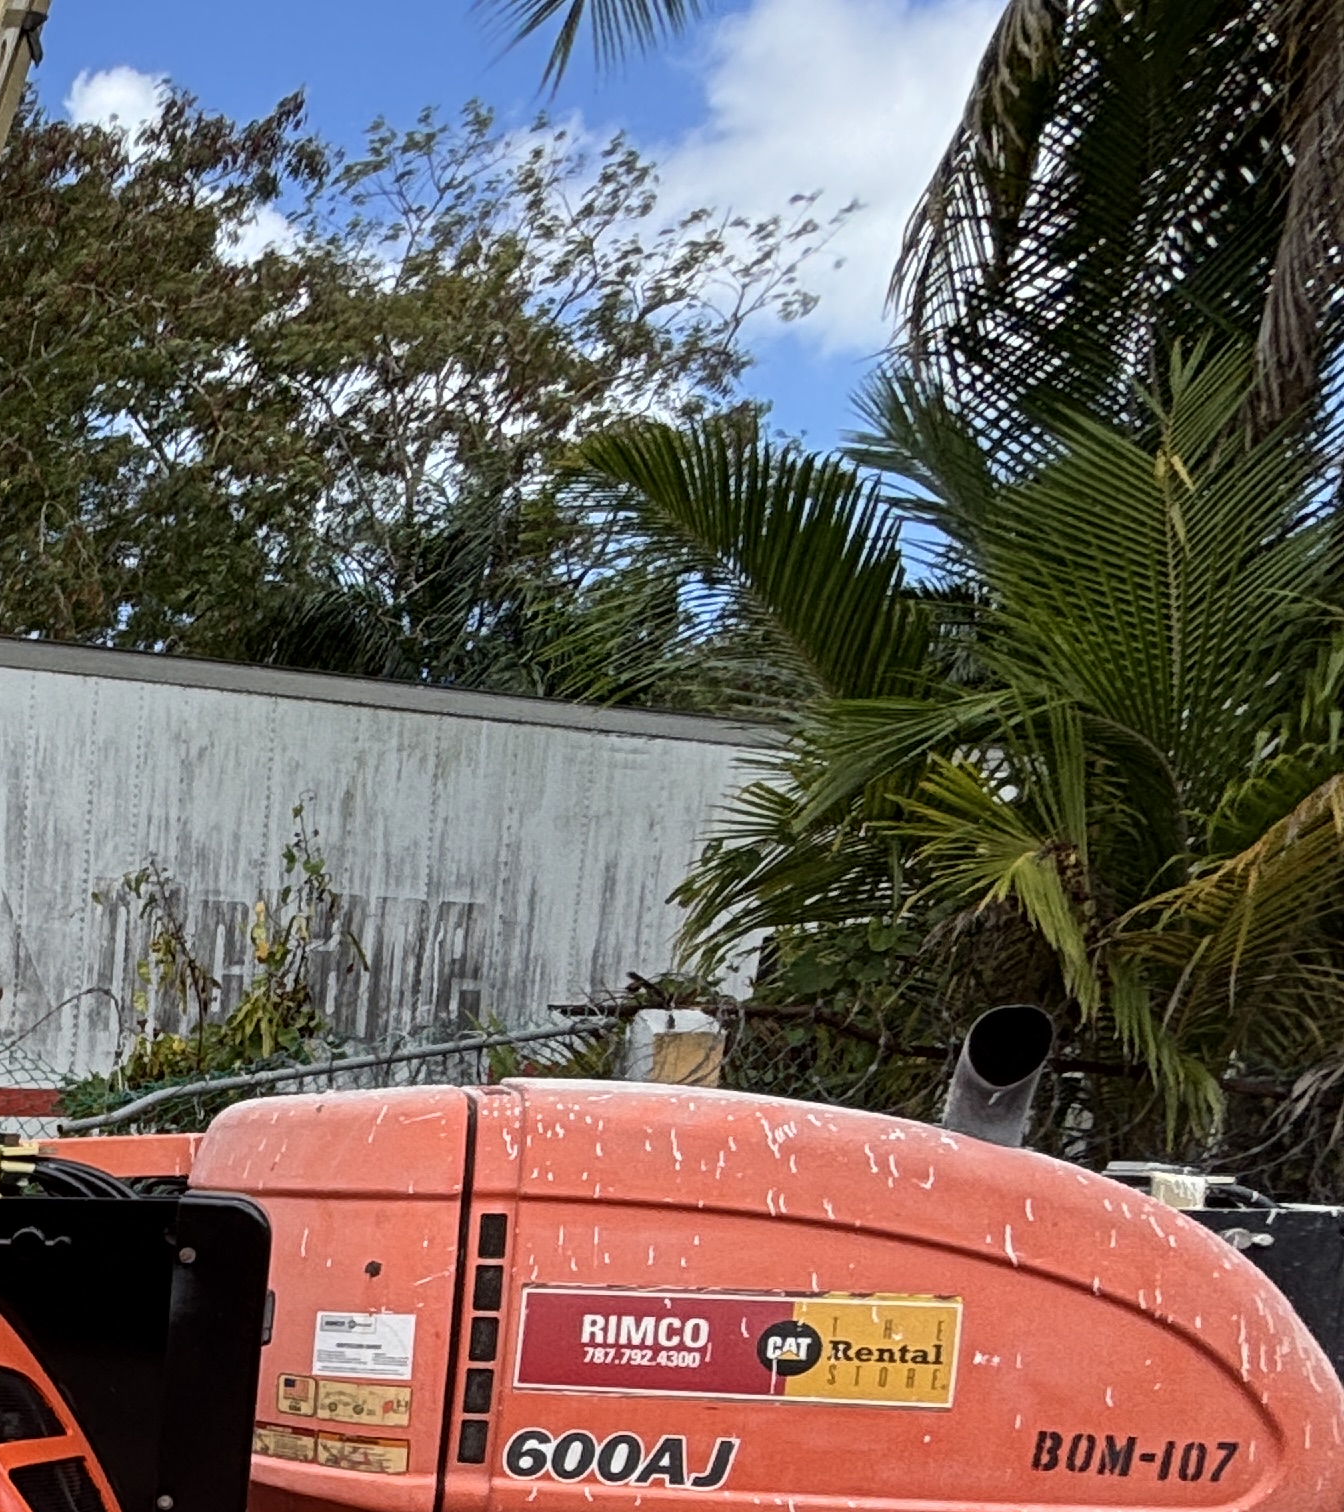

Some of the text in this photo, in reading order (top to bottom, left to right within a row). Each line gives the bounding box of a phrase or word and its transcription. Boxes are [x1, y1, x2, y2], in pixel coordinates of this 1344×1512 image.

[580, 1314, 710, 1349] RIMCO
[830, 1316, 945, 1342] THE
[583, 1346, 702, 1368] 787.792.4300
[766, 1336, 945, 1366] CAT Rental
[504, 1427, 740, 1491] 600AJ
[1031, 1430, 1240, 1483] BOM-107
